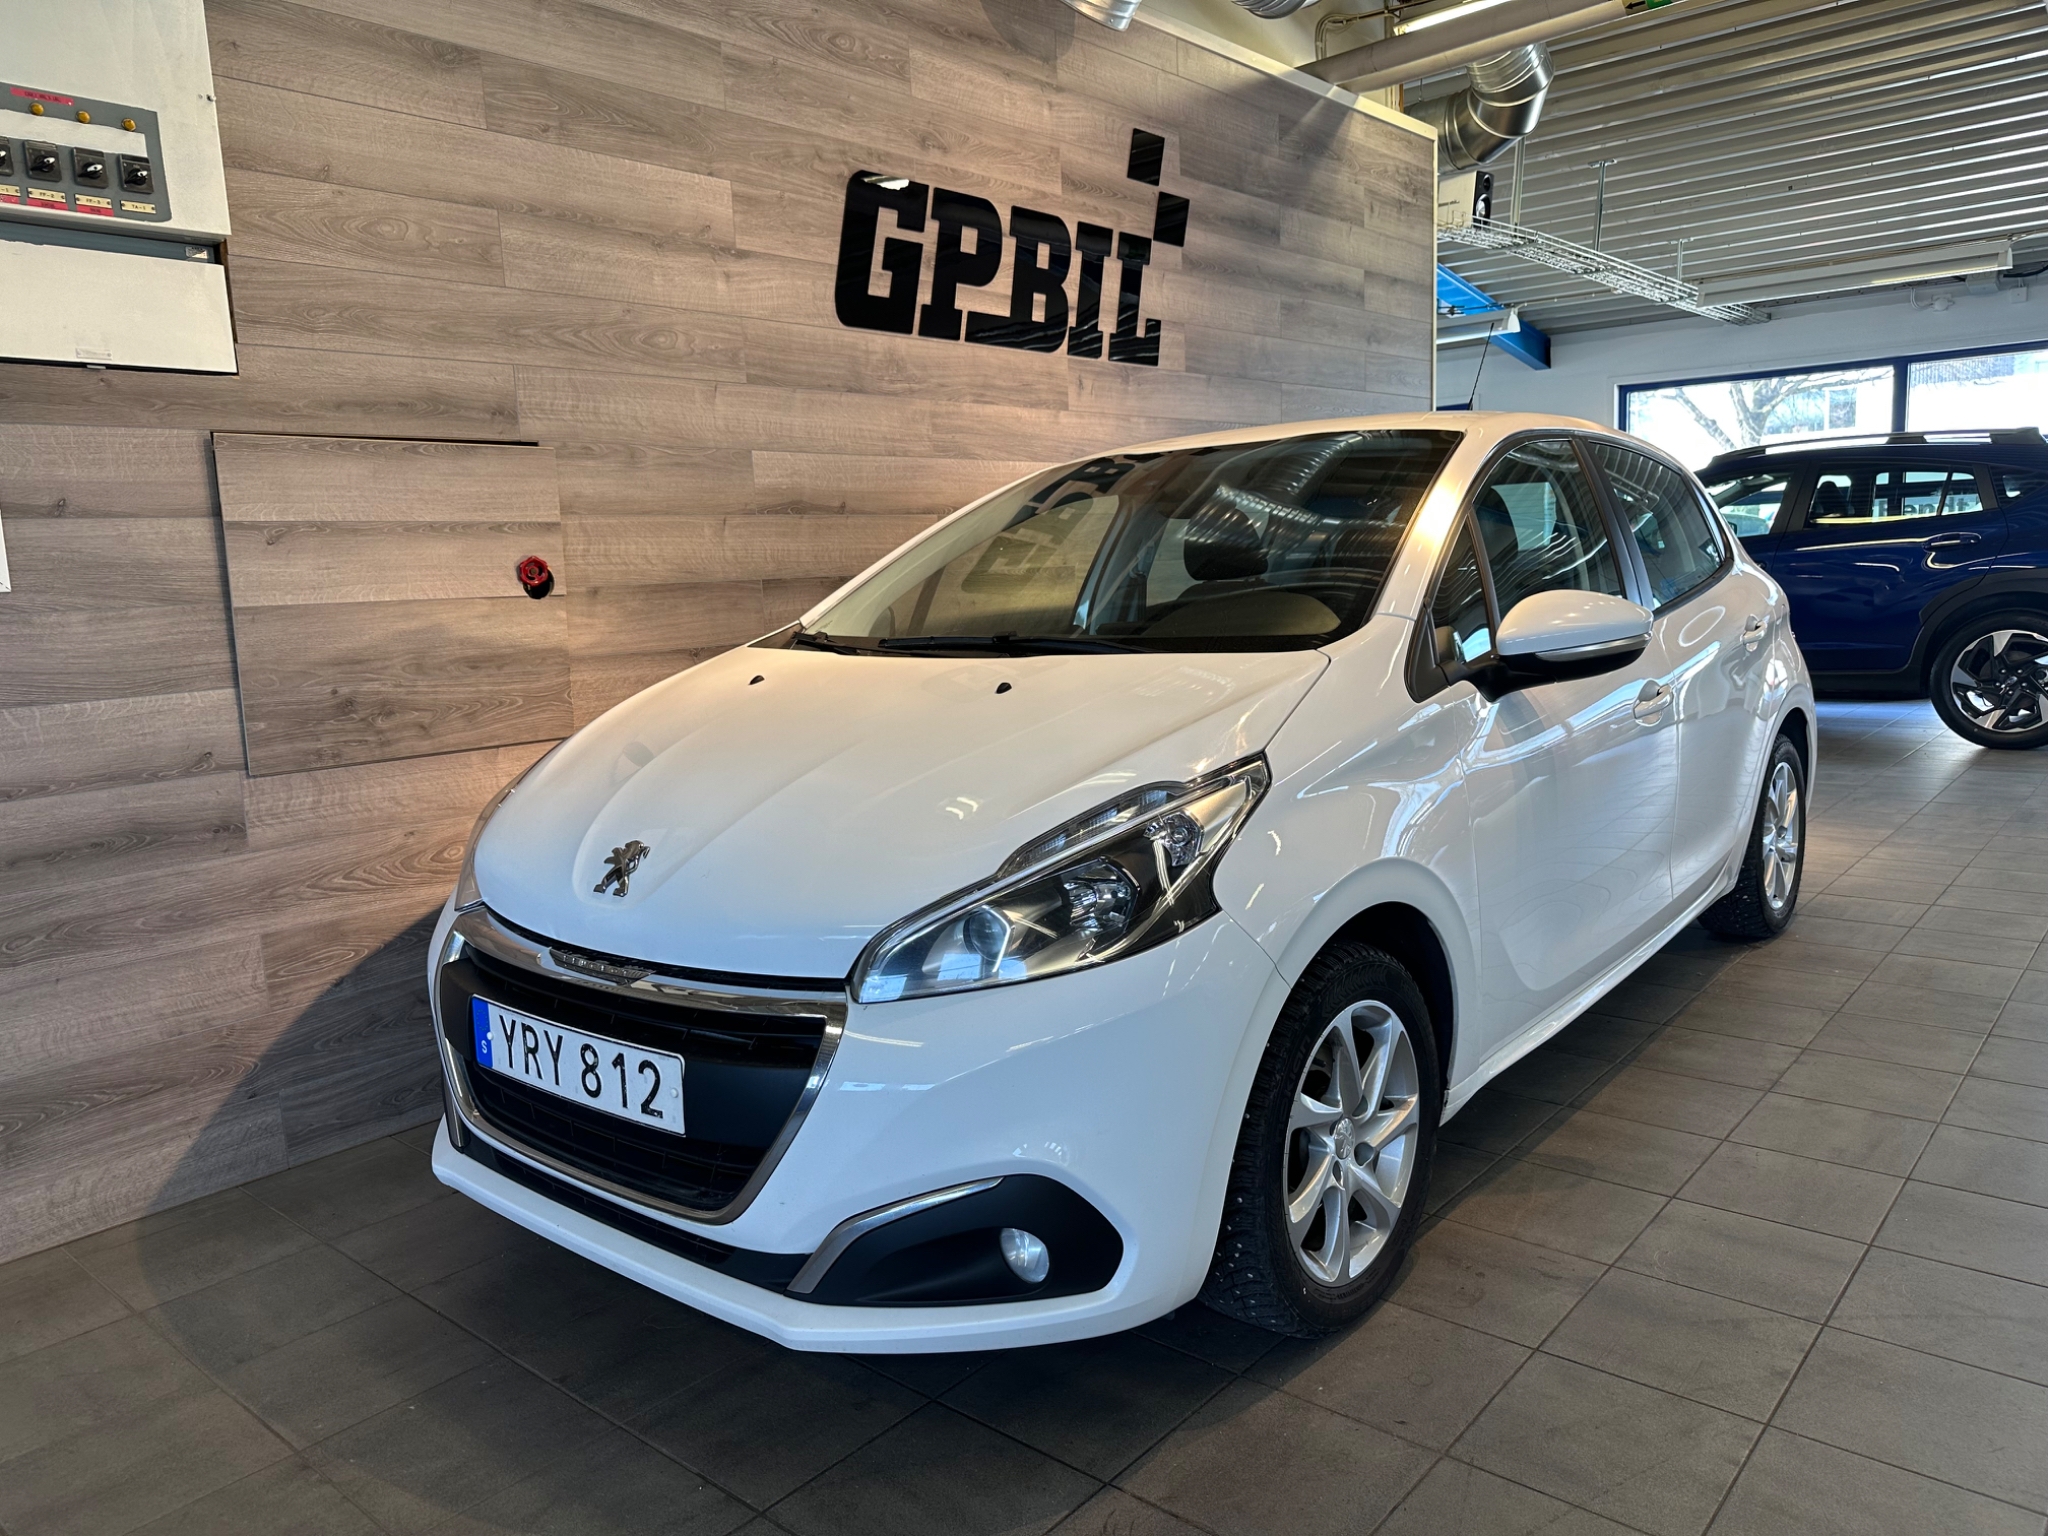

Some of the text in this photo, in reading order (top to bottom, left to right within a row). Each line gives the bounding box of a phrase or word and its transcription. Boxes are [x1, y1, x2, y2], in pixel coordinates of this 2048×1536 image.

[835, 170, 1162, 367] GPBIL
[481, 1039, 488, 1054] S
[498, 1014, 664, 1119] YRY 812
